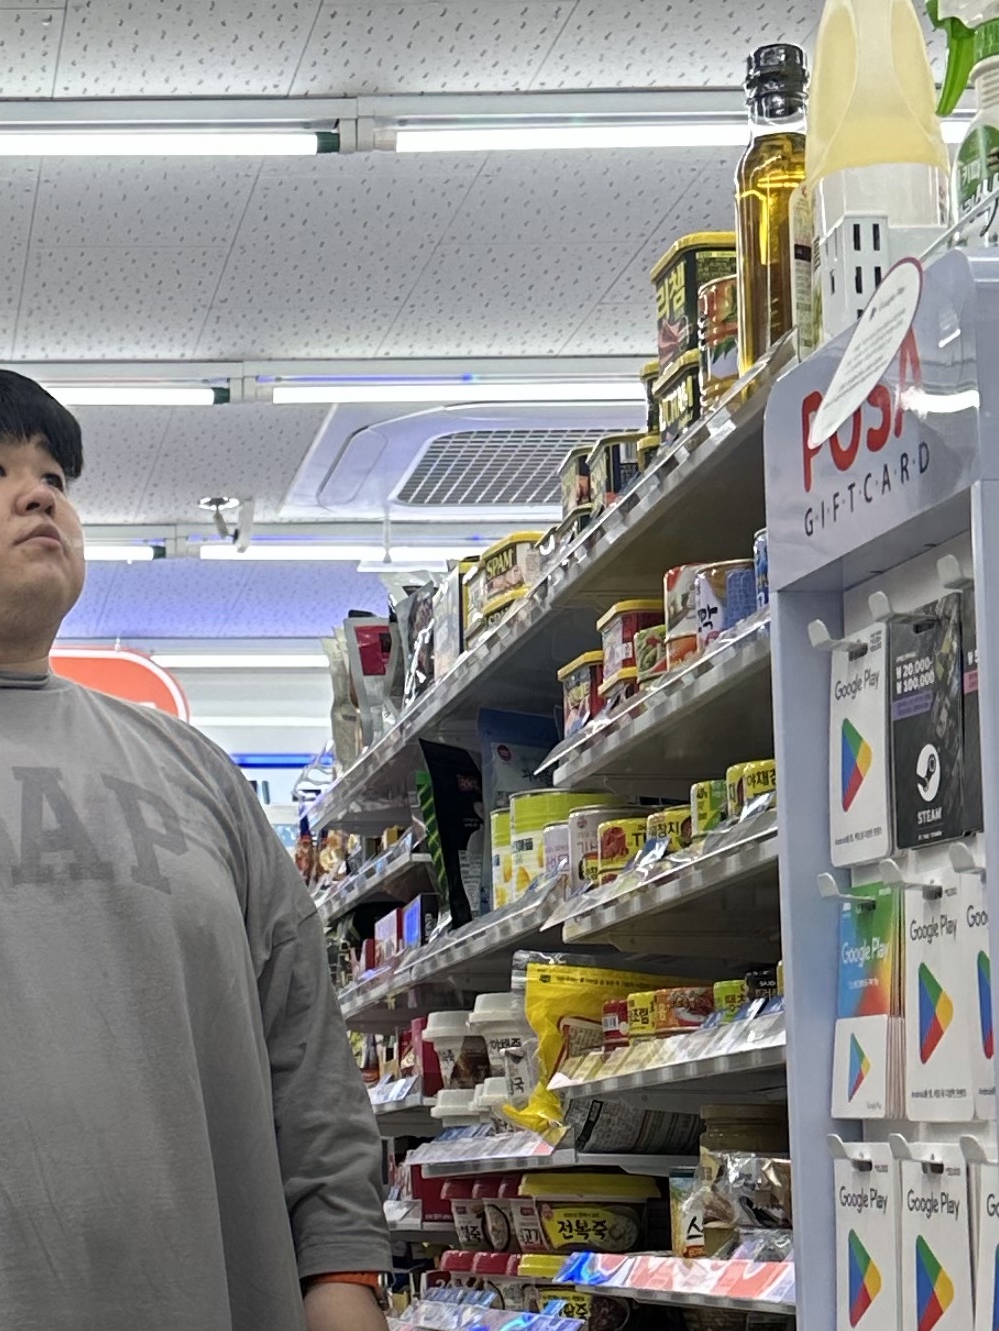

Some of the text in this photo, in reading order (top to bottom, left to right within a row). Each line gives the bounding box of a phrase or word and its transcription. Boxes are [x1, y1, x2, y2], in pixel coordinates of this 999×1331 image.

[486, 546, 514, 579] SPAM
[835, 667, 881, 702] Google Play
[917, 807, 942, 825] STEAM
[910, 913, 959, 946] Google Play
[841, 936, 889, 968] Google Play
[839, 1186, 888, 1216] Google Play
[907, 1188, 960, 1222] Google Play
[557, 1220, 606, 1241] 전복죽
